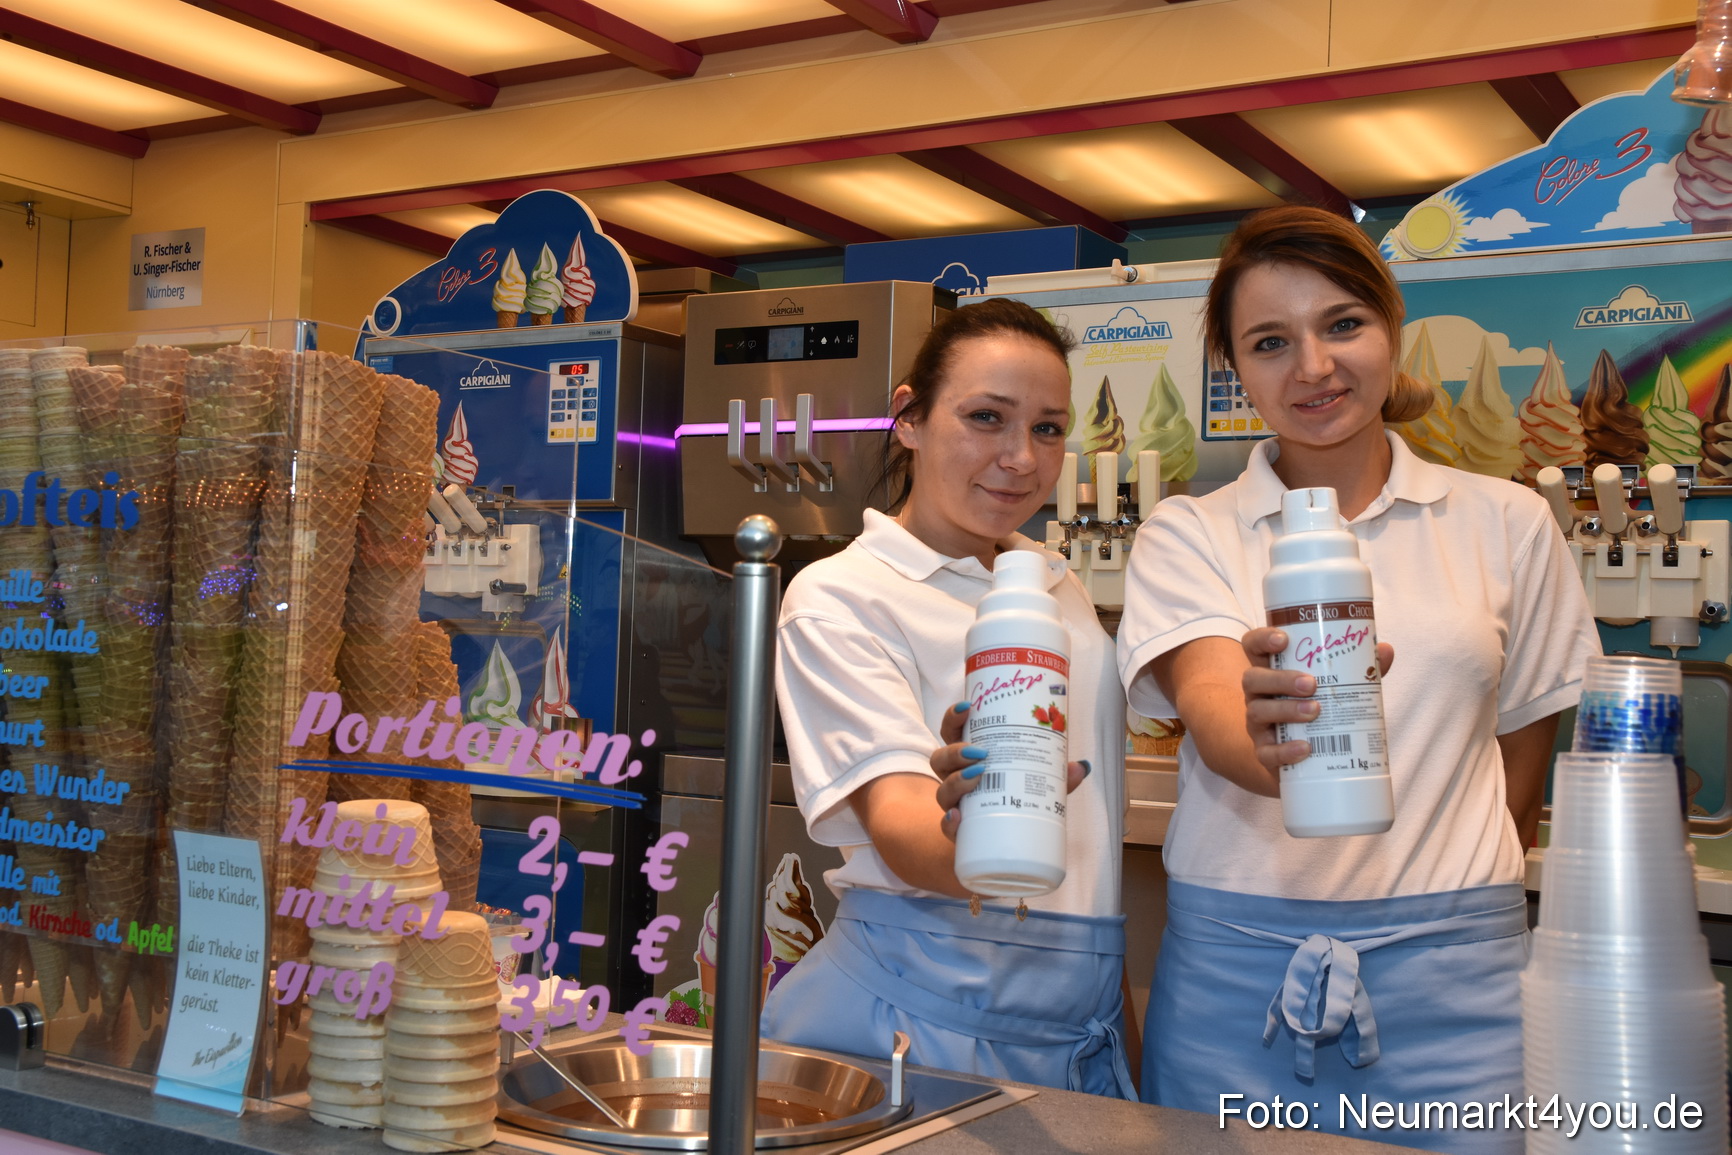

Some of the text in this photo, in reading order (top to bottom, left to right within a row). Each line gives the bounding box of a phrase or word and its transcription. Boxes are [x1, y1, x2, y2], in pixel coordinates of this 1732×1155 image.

[1535, 127, 1653, 205] Colore 3
[144, 241, 191, 257] R. Fischer &
[133, 259, 201, 277] U. Singer-Fischer
[468, 247, 499, 286] 3
[146, 285, 185, 300] Nürnberg
[768, 306, 804, 316] CARPIGIANI
[1583, 305, 1683, 325] CARPIGIANI
[1088, 324, 1166, 341] CARPIGIANI
[459, 374, 511, 387] CARPIGIANI
[571, 364, 583, 375] 05
[975, 651, 1017, 668] ERDBEERE
[970, 715, 1007, 730] ERDBEERE
[289, 691, 656, 786] Portionen:
[1350, 758, 1355, 769] 1
[1357, 758, 1369, 770] kg
[33, 763, 131, 806] Wunder
[1002, 796, 1006, 806] 1
[1010, 795, 1022, 809] kg
[280, 798, 418, 866] klein
[640, 831, 690, 892] €
[186, 855, 256, 883] Liebe Eltern,
[31, 870, 62, 897] mit
[188, 880, 260, 910] liebe Kinder,
[29, 904, 93, 939] Kirsche
[127, 921, 174, 955] Apfel
[276, 874, 451, 940] mittel
[631, 915, 681, 975] €
[187, 934, 259, 964] die Theke ist
[185, 961, 255, 990] kein Kletter-
[179, 993, 218, 1013] gerüst.
[270, 960, 667, 1056] groß 3,50 €
